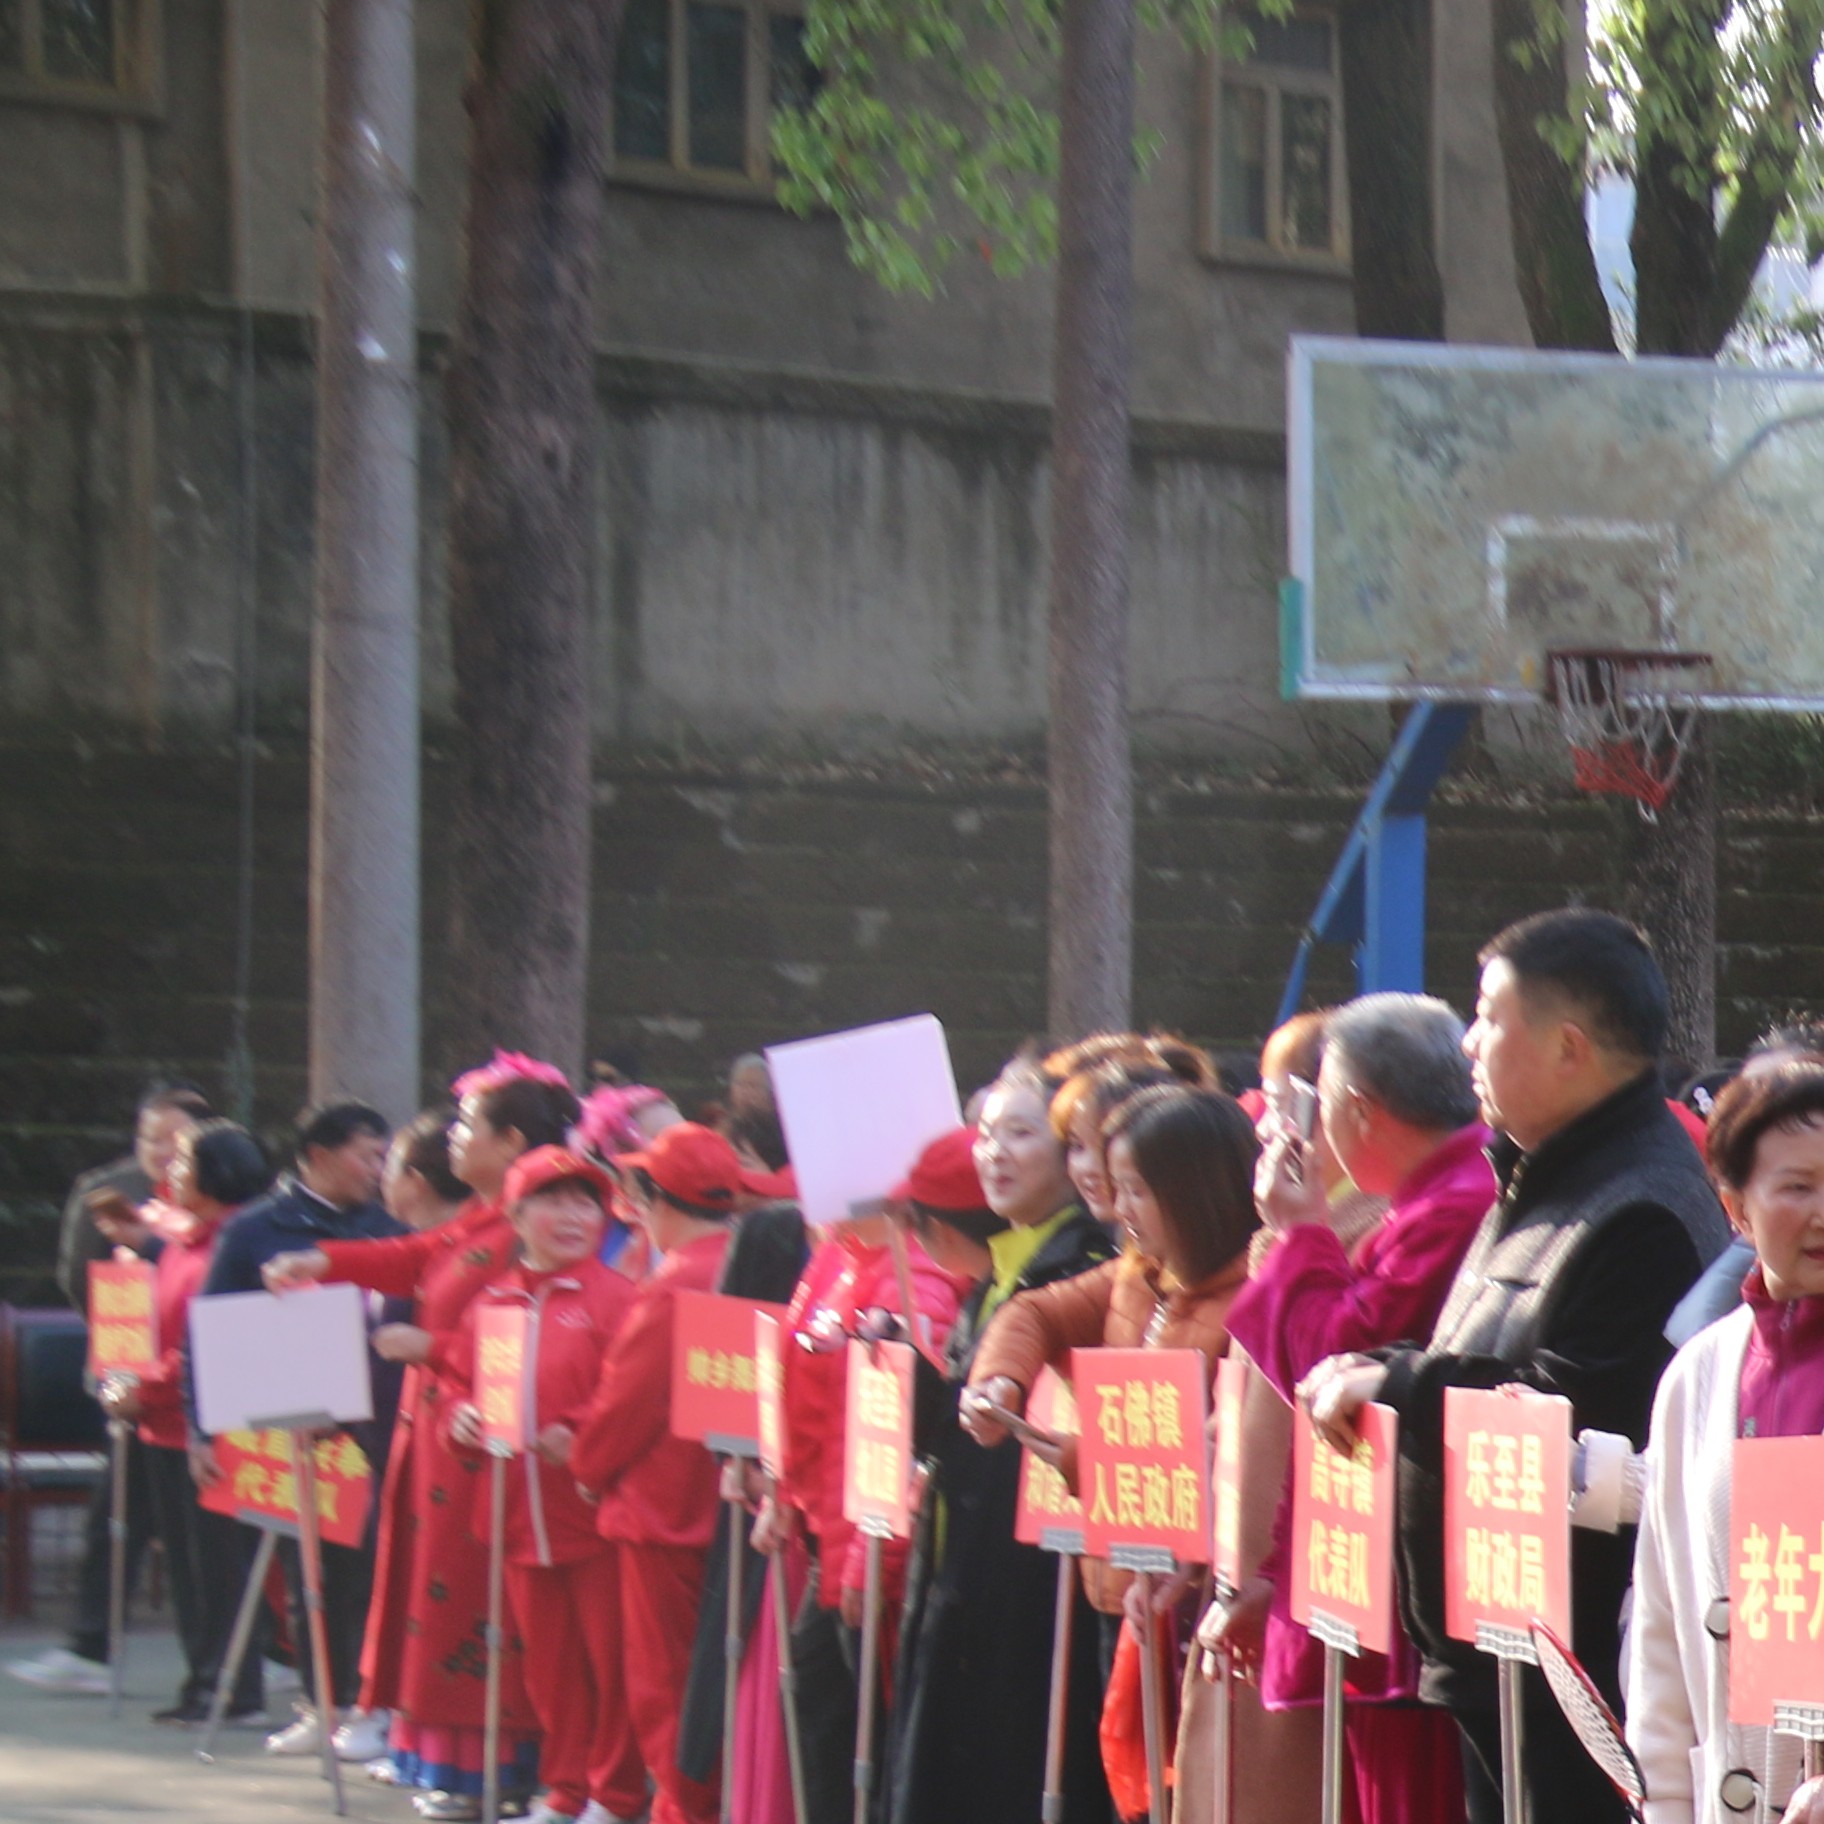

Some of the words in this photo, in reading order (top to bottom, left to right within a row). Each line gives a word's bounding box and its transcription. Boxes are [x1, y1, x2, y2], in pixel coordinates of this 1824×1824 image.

[1095, 1379, 1184, 1450] 石佛镇
[1088, 1461, 1199, 1532] 人民政府
[1465, 1428, 1546, 1515] 乐至县
[1465, 1527, 1546, 1615] 财政局
